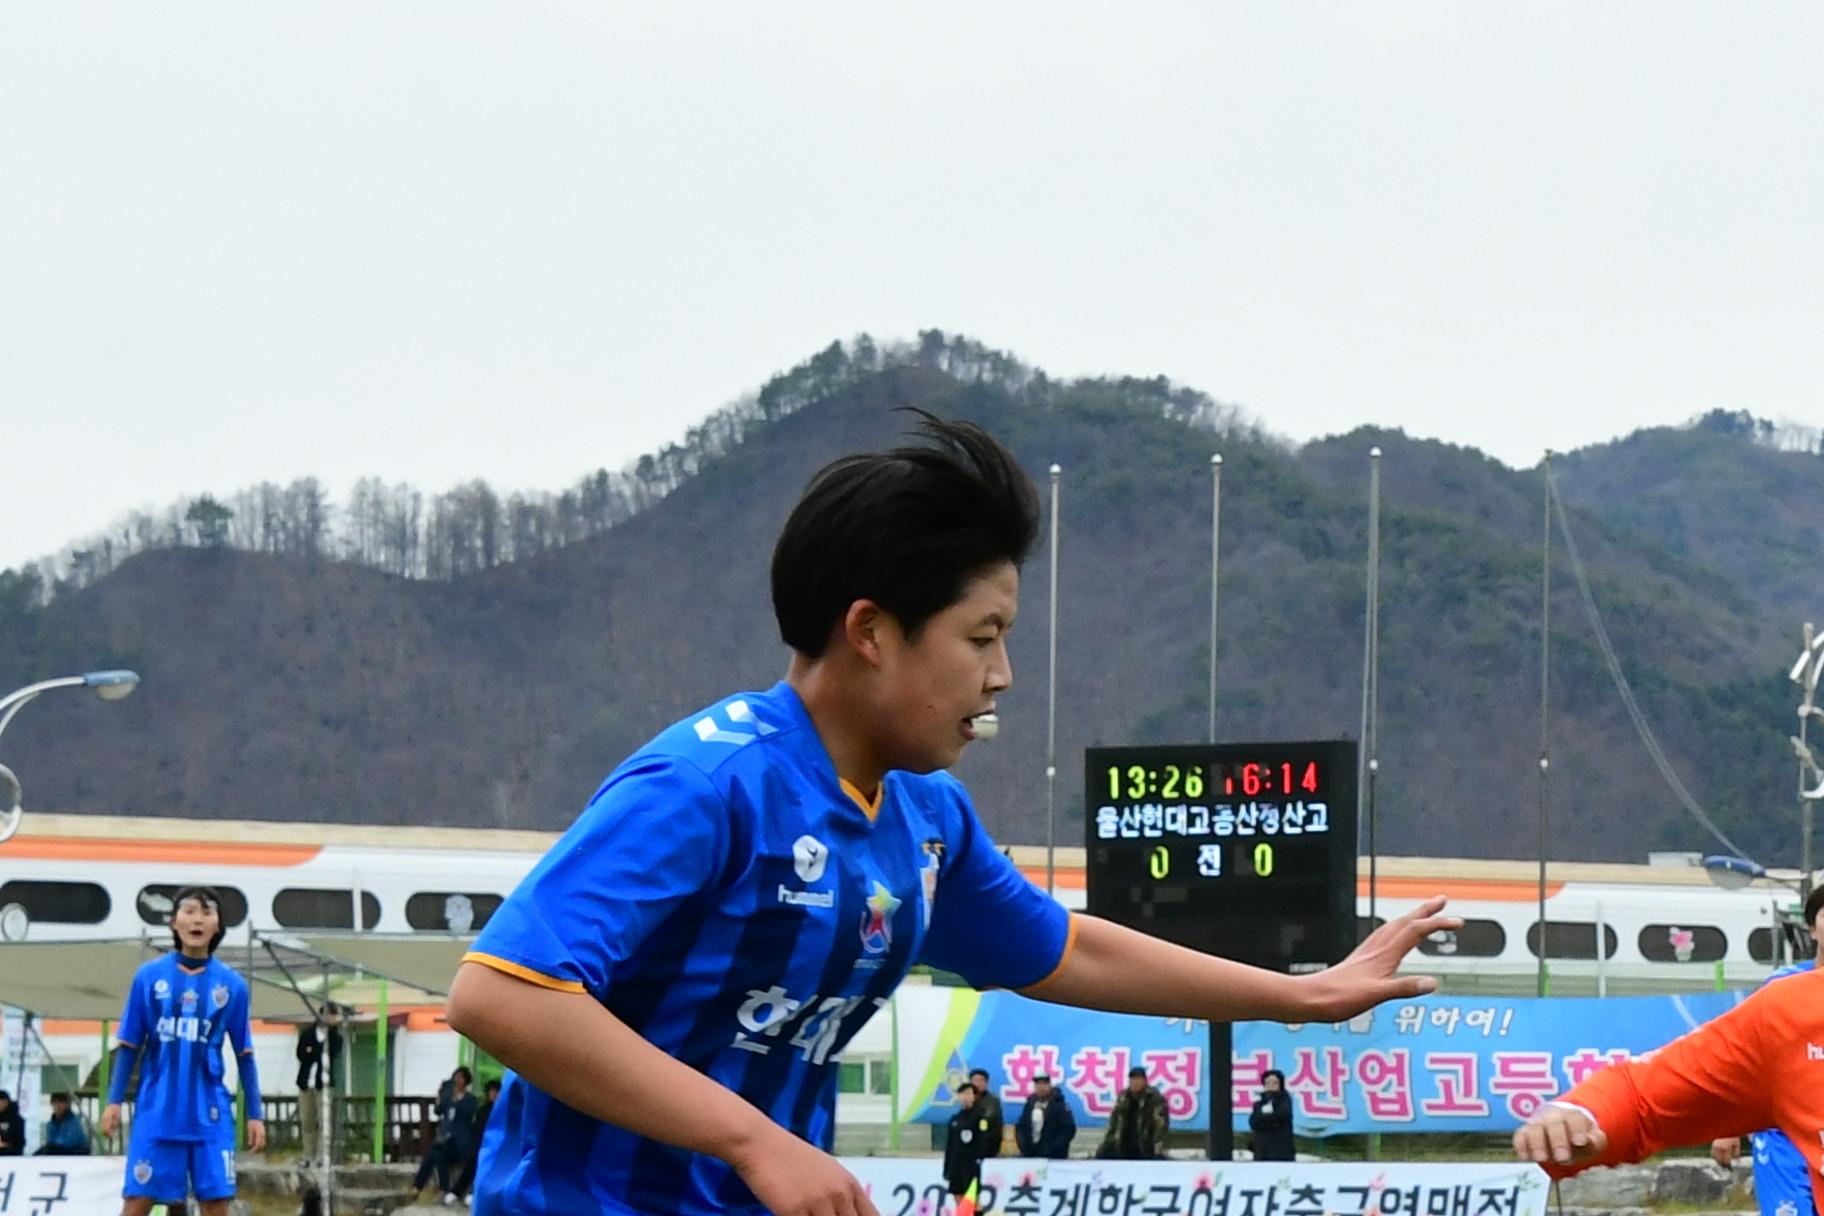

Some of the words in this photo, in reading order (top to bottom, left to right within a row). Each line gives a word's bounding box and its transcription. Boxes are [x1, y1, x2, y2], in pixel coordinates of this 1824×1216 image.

[1108, 765, 1203, 800] 13:26
[1151, 847, 1169, 879] 0
[1254, 843, 1273, 877] 0
